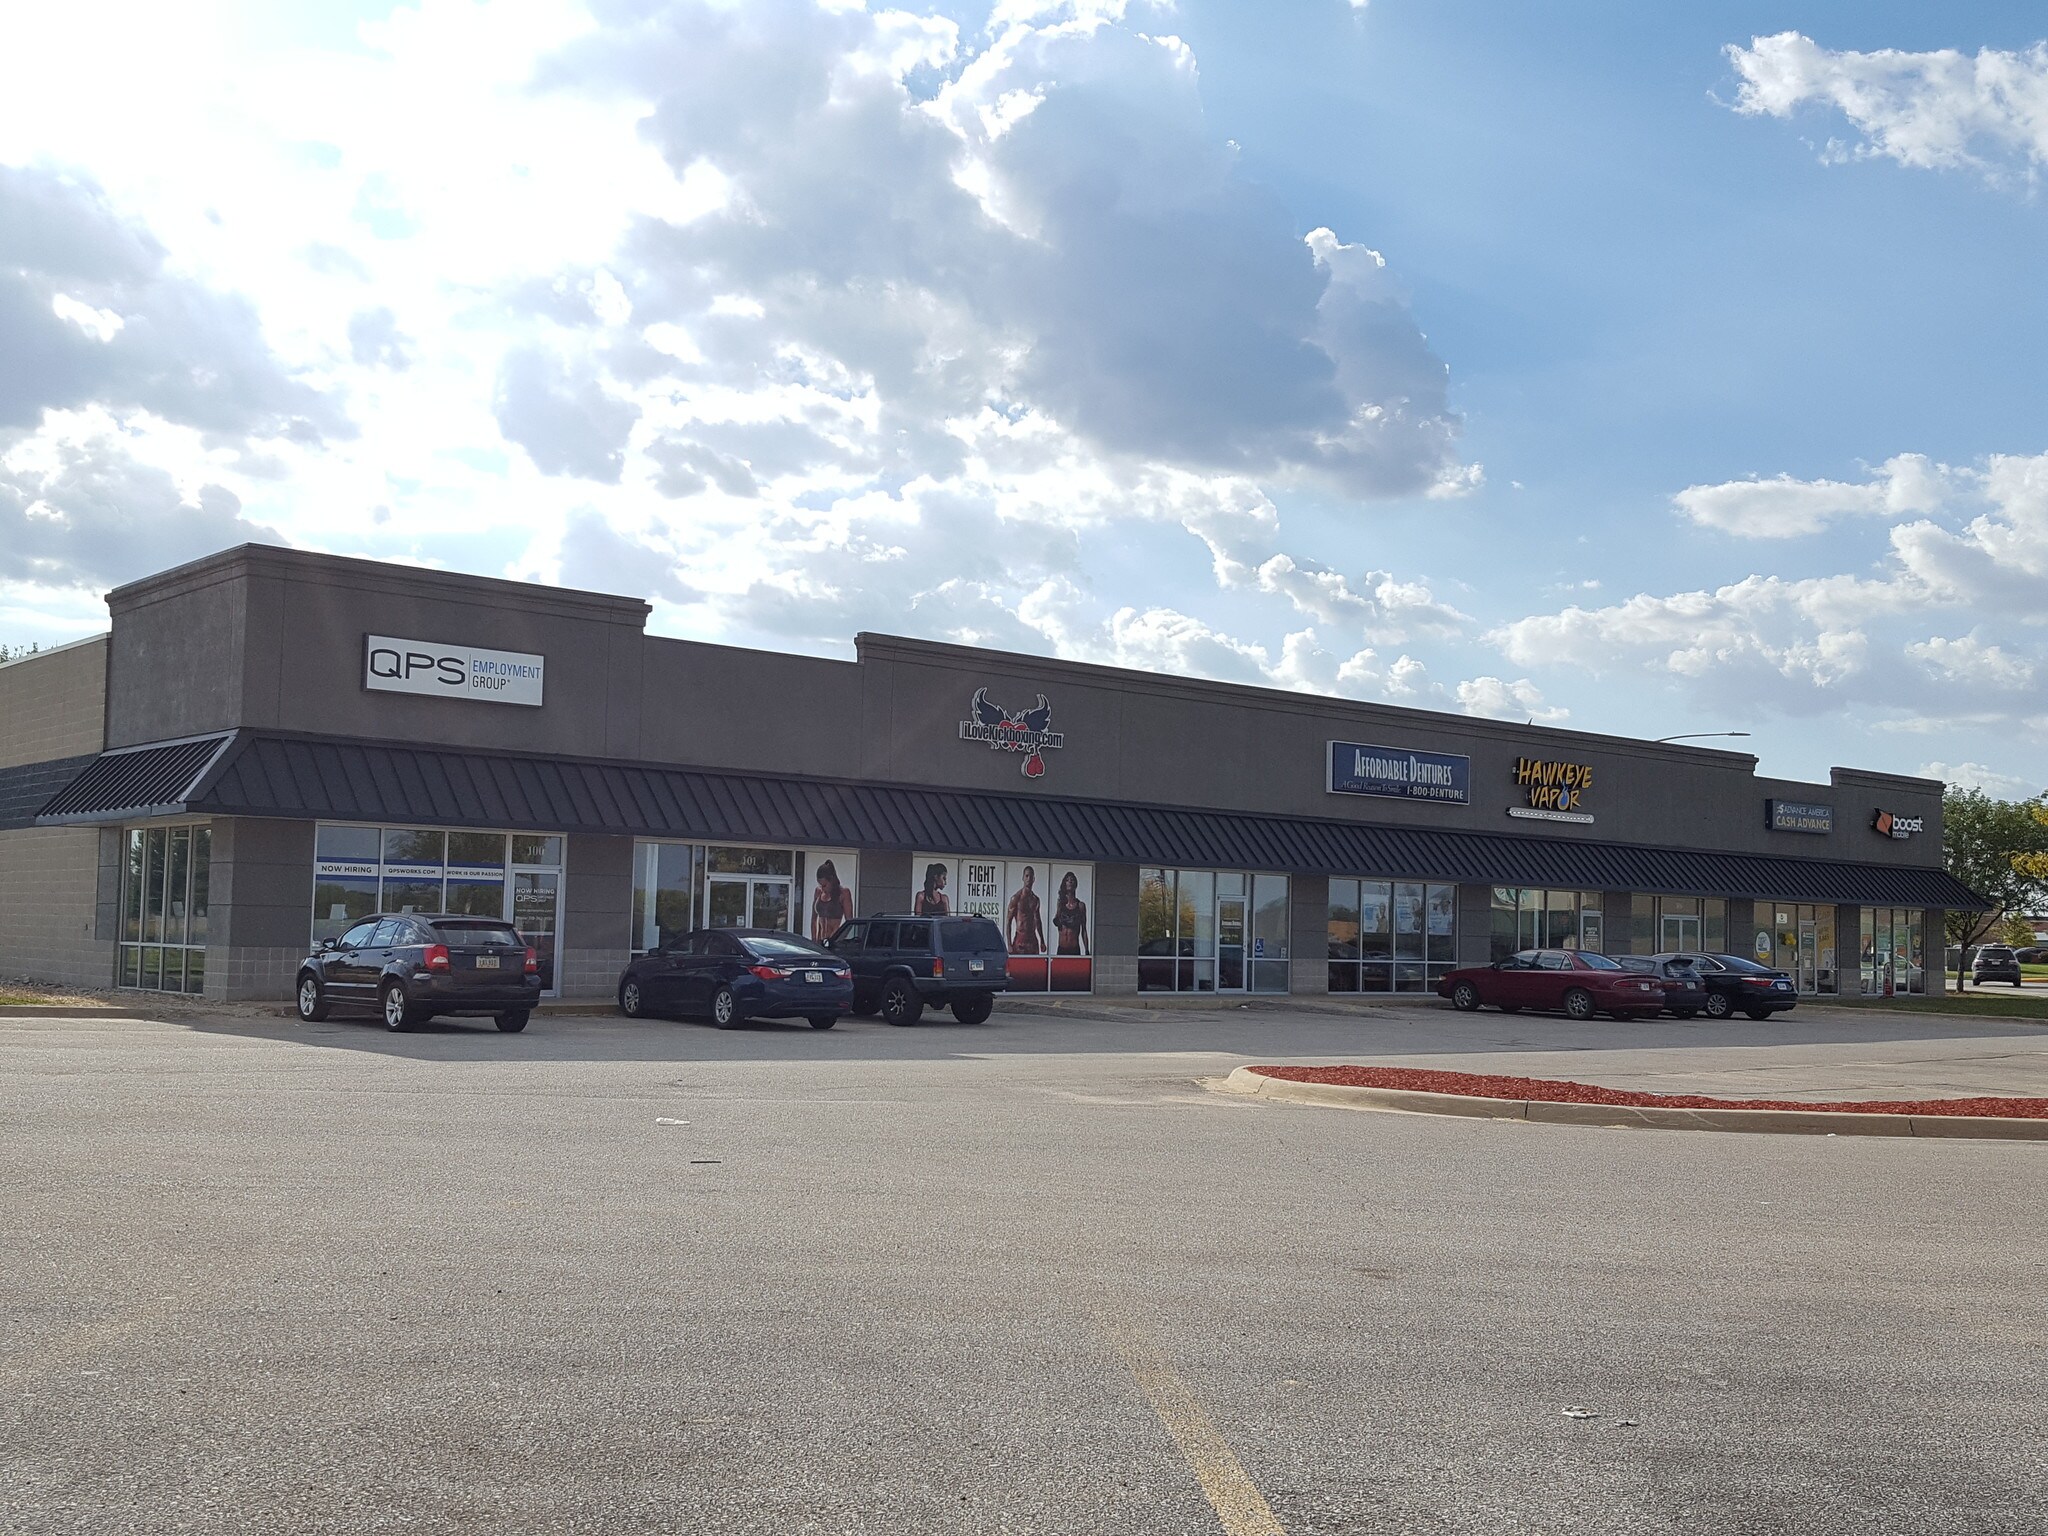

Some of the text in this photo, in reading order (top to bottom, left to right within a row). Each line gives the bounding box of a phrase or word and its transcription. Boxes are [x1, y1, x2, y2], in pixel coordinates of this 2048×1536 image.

[370, 648, 466, 685] QPS
[472, 659, 541, 679] EMPLOYMENT
[472, 676, 507, 690] GROUP
[1354, 749, 1452, 785] AFFORDABLE DENTURES
[1518, 757, 1593, 788] HAWKEYE
[1407, 785, 1464, 800] 1-800-DENTURE
[1531, 786, 1581, 811] VAPOR
[1776, 815, 1830, 830] CASH ADVANCE
[1892, 814, 1923, 832] boost
[1892, 831, 1910, 839] mobile
[321, 865, 373, 874] NOW HIRING
[969, 865, 996, 883] FIGHT
[967, 883, 997, 898] THE FAT!
[516, 894, 538, 903] QPS
[970, 901, 1000, 915] CLASSES
